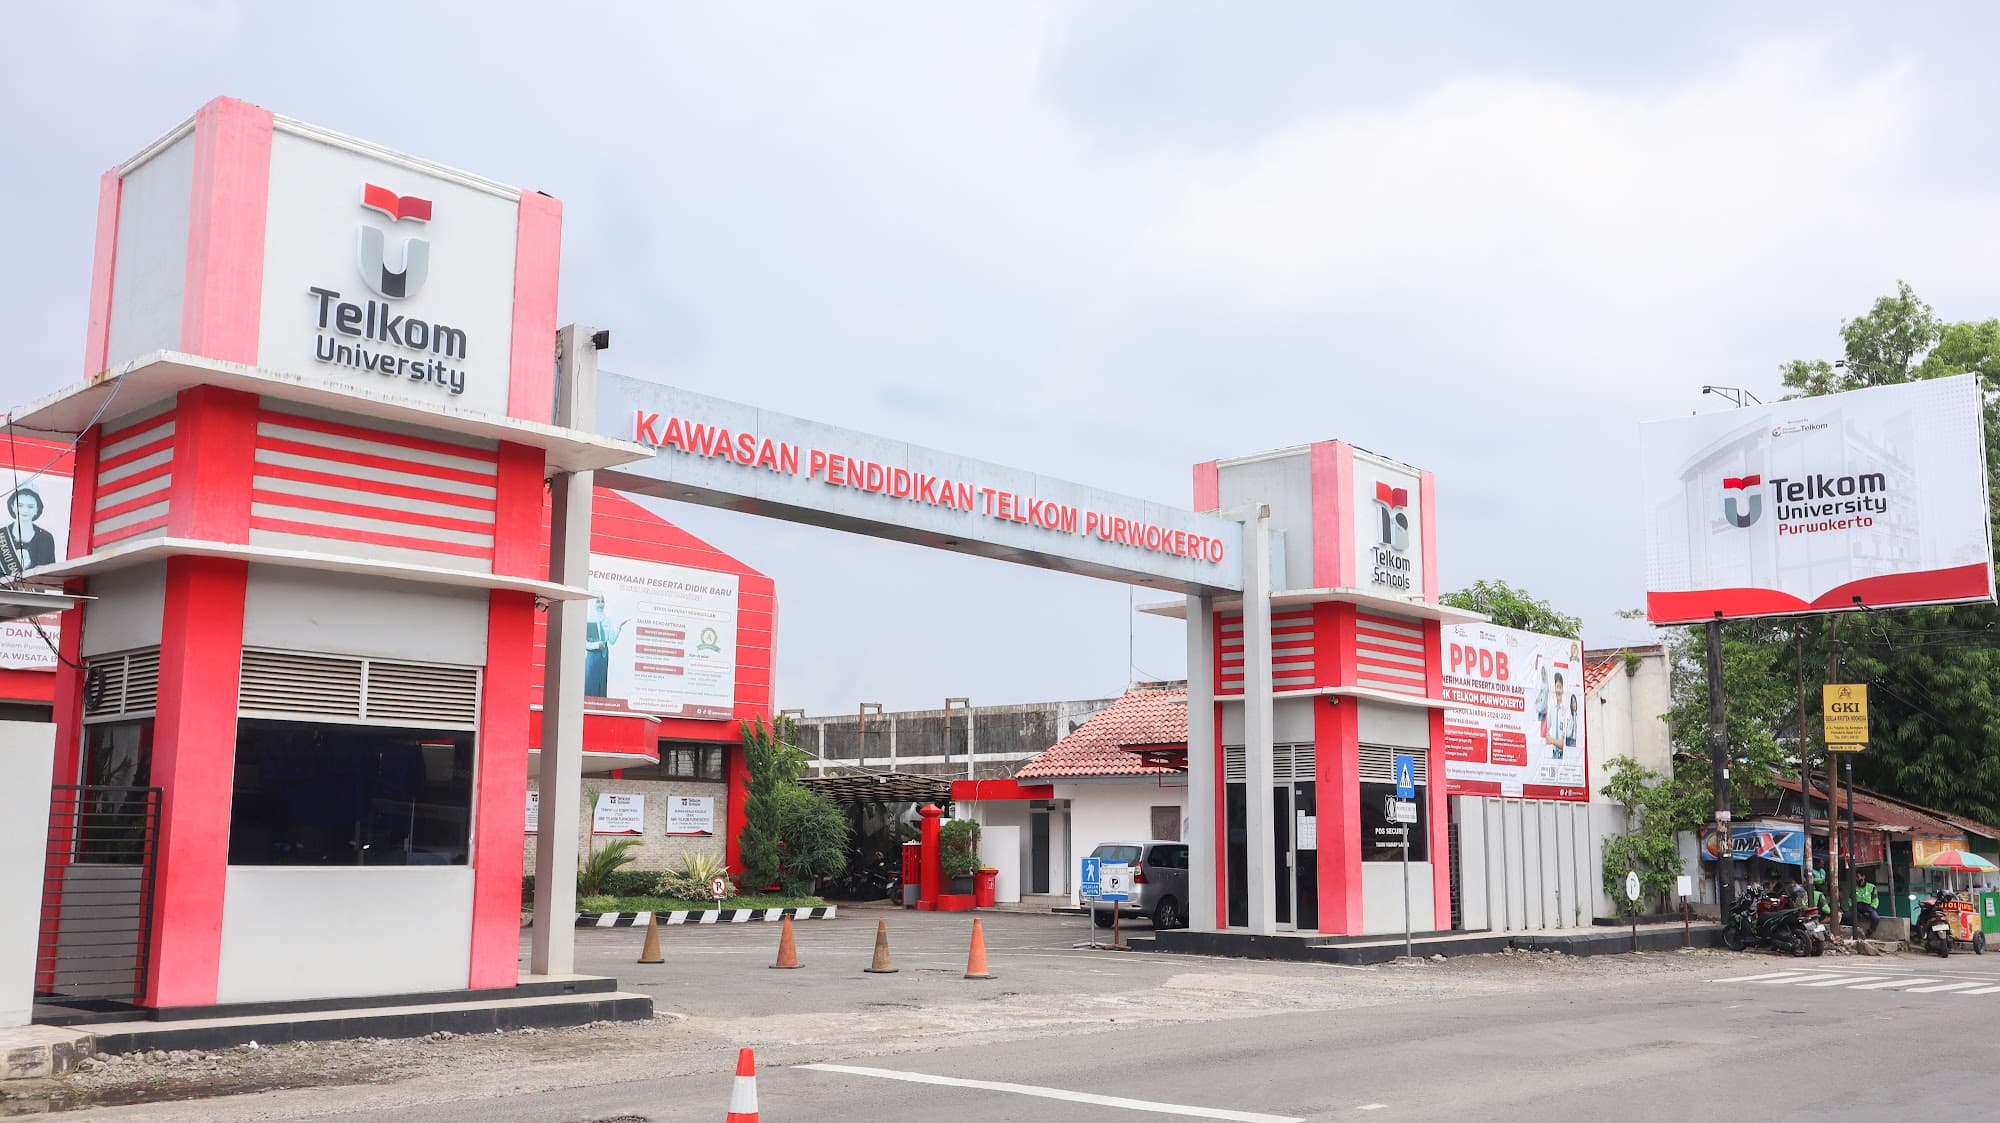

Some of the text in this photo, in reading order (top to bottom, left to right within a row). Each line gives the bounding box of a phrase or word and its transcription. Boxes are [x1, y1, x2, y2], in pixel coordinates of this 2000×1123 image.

[309, 286, 467, 360] Telkom
[315, 335, 465, 396] University
[1800, 423, 1828, 432] Telkom
[634, 410, 1224, 564] KAWASAN PENDIDIKAN TELKOM PURWOKERTO
[1769, 473, 1886, 503] Telkom
[1777, 496, 1887, 520] University
[1779, 515, 1873, 535] Purwokerto
[1372, 546, 1410, 572] Telkom
[588, 570, 645, 585] PENERIMAAN
[647, 578, 683, 591] PESERTA
[685, 583, 708, 594] DIDIK
[709, 587, 732, 597] BARU
[1373, 567, 1410, 589] Schools
[6, 627, 60, 641] DAN SUK
[12, 652, 48, 663] WISATA
[1450, 643, 1509, 681] PPDB
[1442, 674, 1525, 695] NERIMAAN PESERTA DIDIK BARU
[1453, 690, 1479, 704] TELKOM
[1480, 693, 1524, 709] PURWOKERTO
[1831, 702, 1860, 713] GKI
[1375, 827, 1410, 835] POS SECURIY
